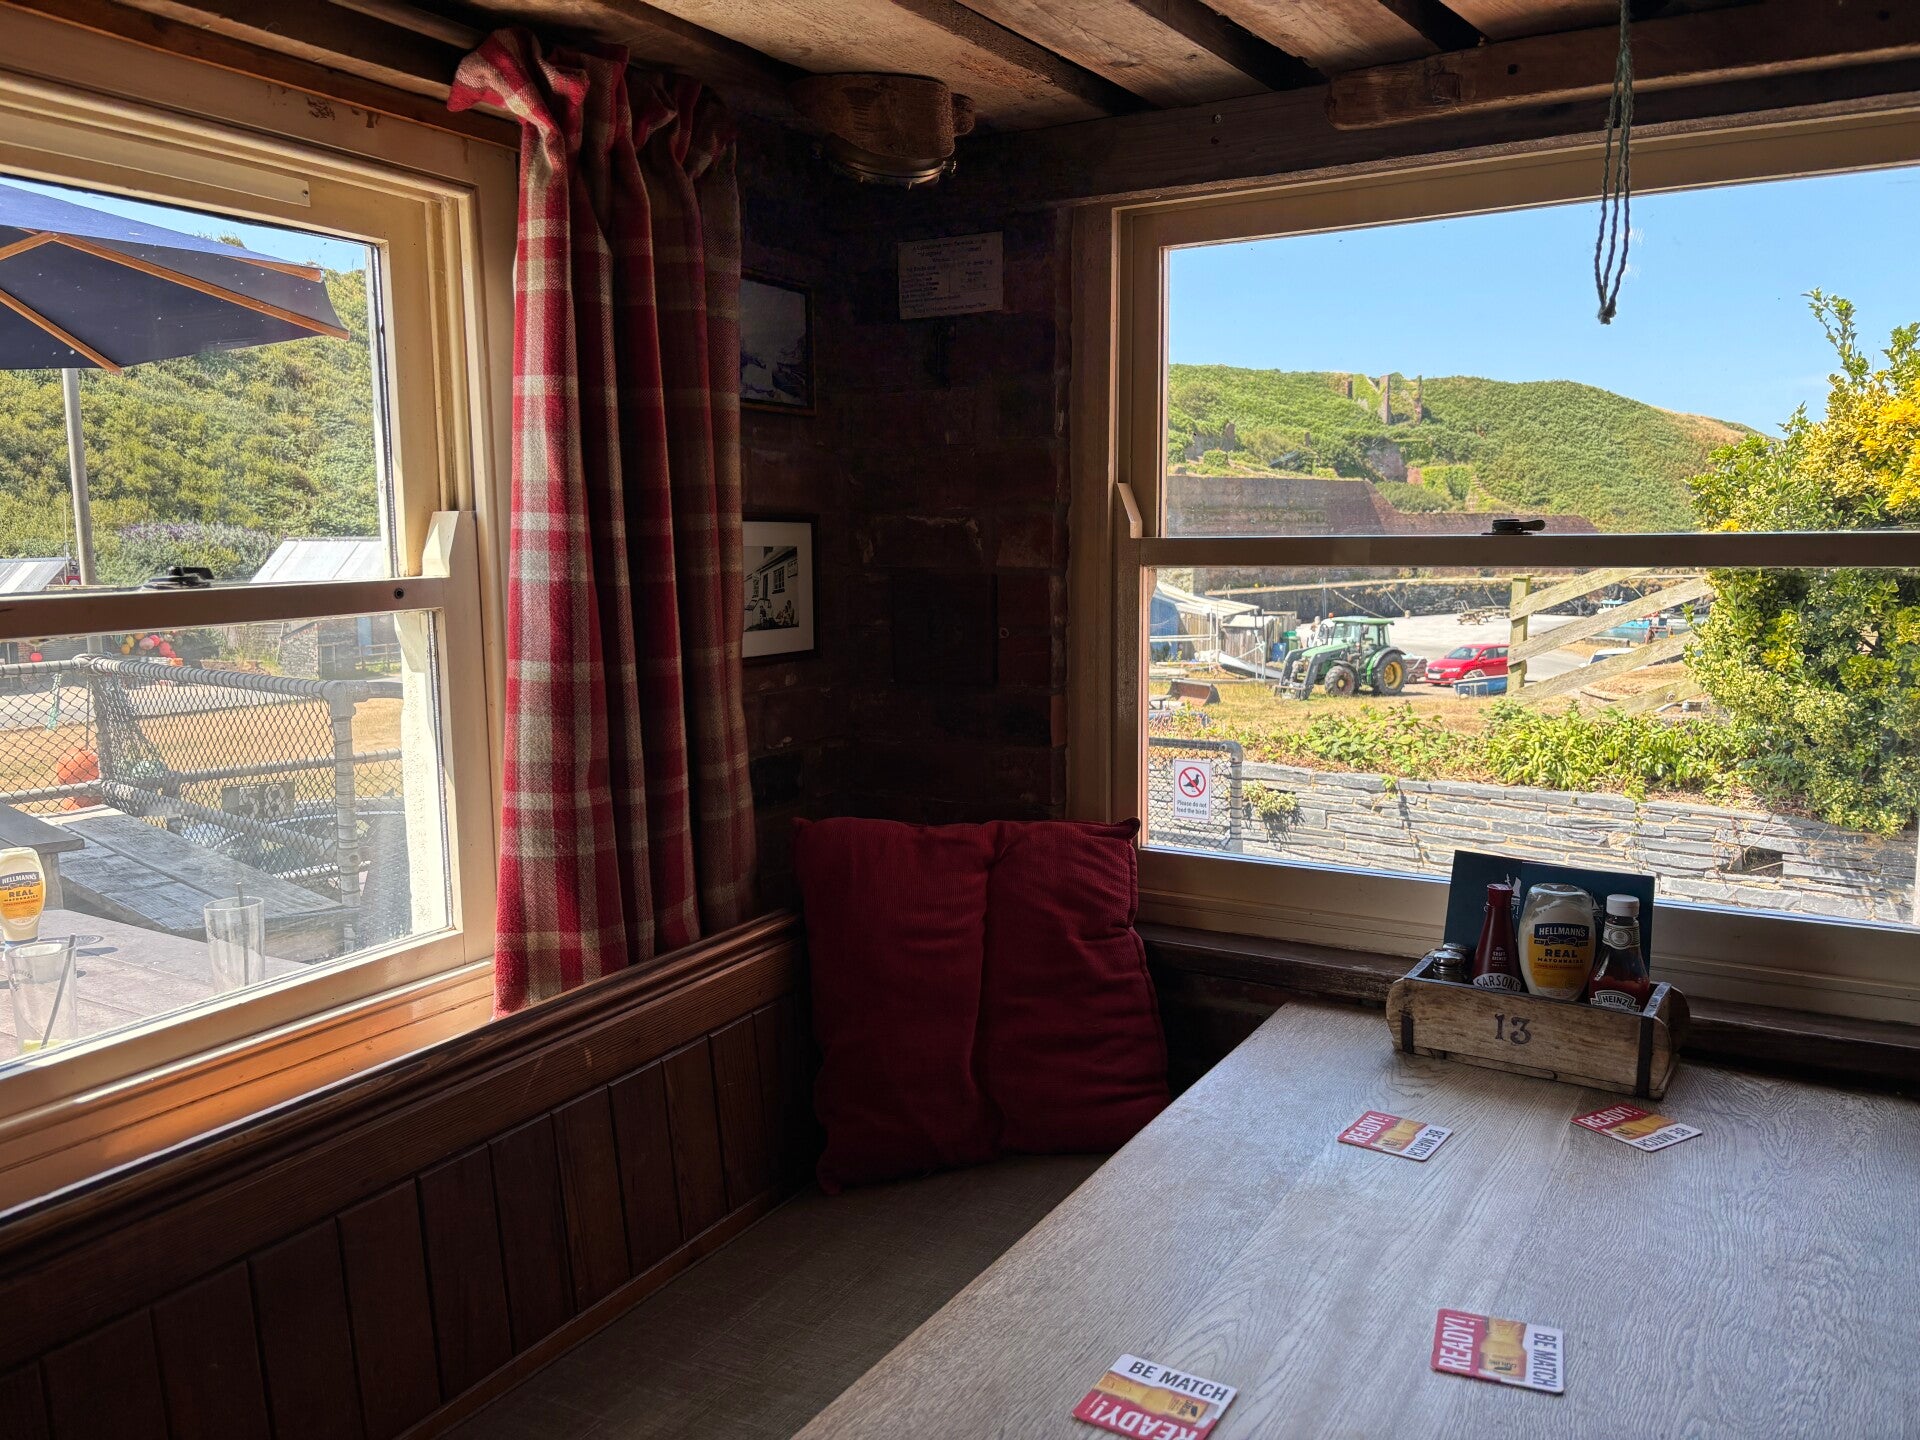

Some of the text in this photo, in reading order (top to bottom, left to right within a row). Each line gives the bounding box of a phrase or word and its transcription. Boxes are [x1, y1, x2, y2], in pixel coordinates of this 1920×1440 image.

[8, 889, 34, 898] REAL
[1538, 927, 1586, 937] HELLMANN'S
[1544, 948, 1578, 959] REAL
[1602, 995, 1629, 1006] HEINZ
[1495, 1013, 1532, 1045] 13
[1577, 1105, 1639, 1128] READY!
[1343, 1114, 1390, 1143] READY!
[1425, 1129, 1446, 1140] BE
[1635, 1127, 1693, 1149] BE MATCH
[1405, 1136, 1439, 1158] MATCH
[1438, 1316, 1477, 1371] READY!
[1532, 1332, 1557, 1388] BE MATCH
[1128, 1360, 1229, 1401] BE MATCH
[1090, 1400, 1198, 1440] READY!
